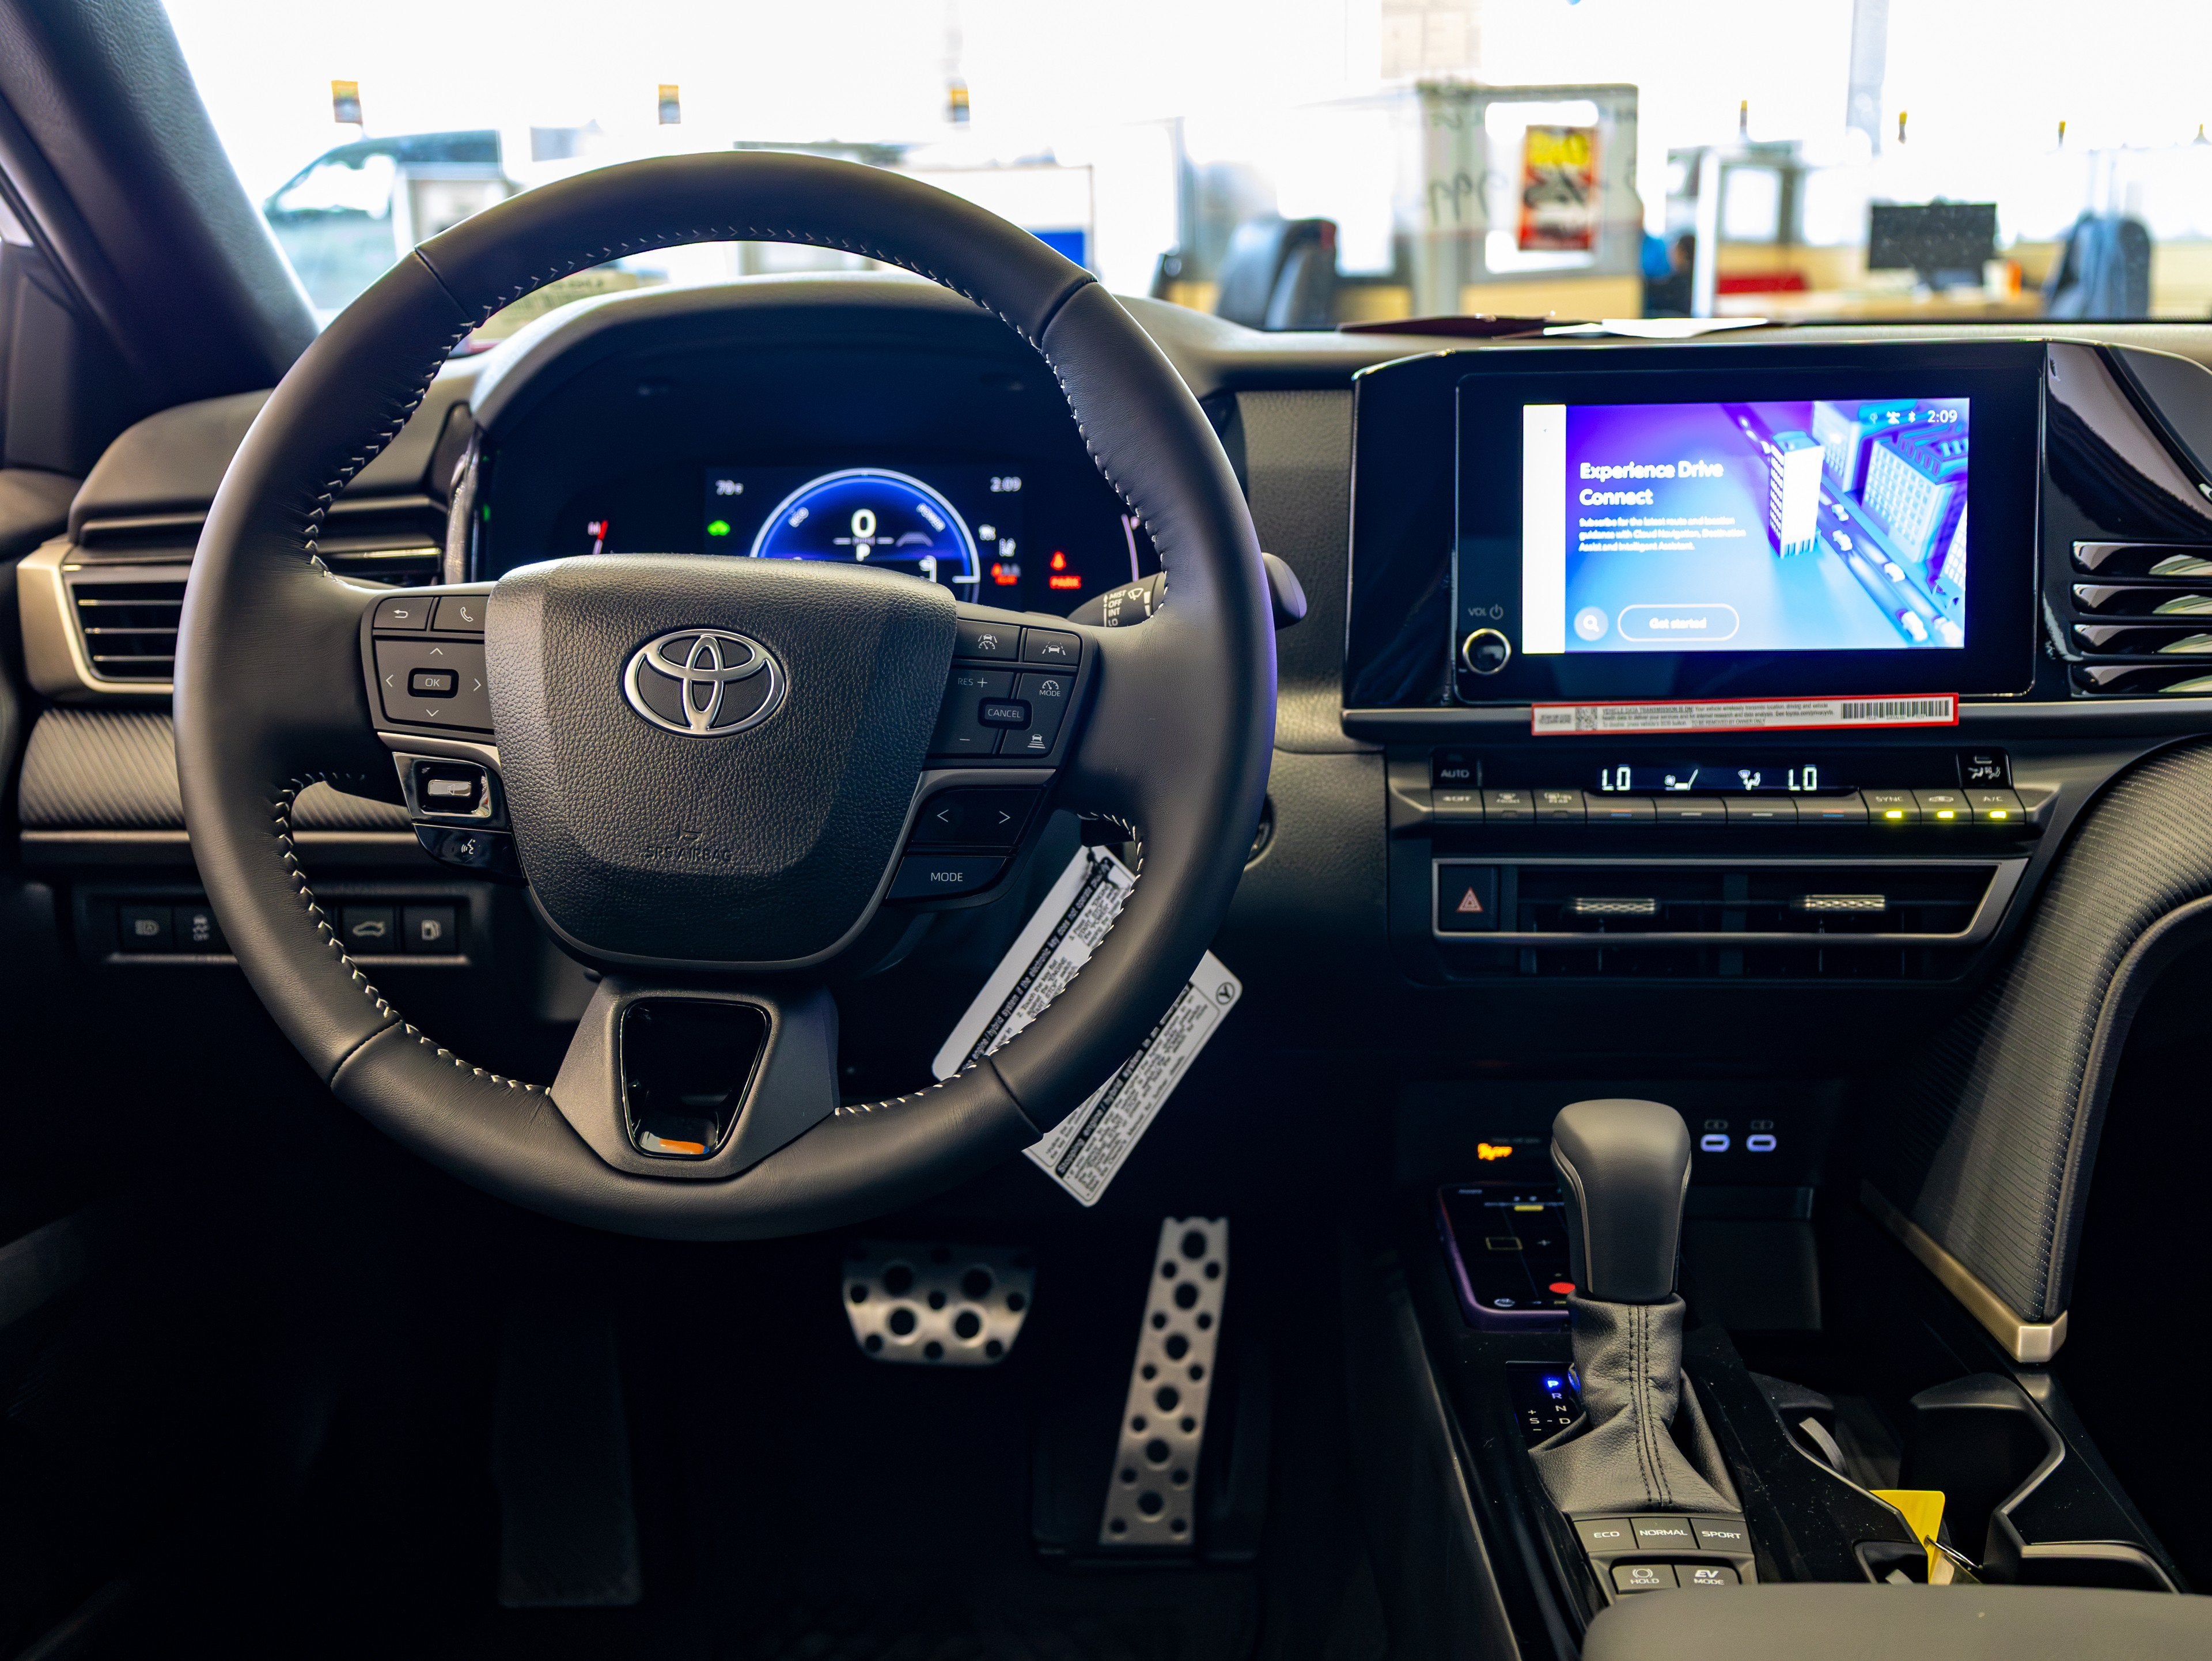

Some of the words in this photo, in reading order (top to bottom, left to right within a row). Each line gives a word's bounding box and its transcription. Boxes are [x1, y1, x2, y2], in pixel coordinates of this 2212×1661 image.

[1927, 410, 1957, 423] 2:09
[1580, 461, 1675, 482] Experience
[1678, 460, 1724, 478] Drive
[1580, 489, 1653, 505] Connect
[851, 508, 876, 538] 0
[856, 543, 870, 567] P
[1109, 590, 1127, 600] MIST
[1108, 599, 1123, 608] OFF
[1108, 608, 1121, 617] INT
[1468, 607, 1487, 616] VOL
[1649, 618, 1669, 629] Get
[1671, 617, 1707, 629] started
[425, 678, 440, 687] OK
[958, 678, 974, 686] RES
[987, 709, 1021, 718] CANCEL
[1441, 769, 1469, 778] AUTO
[931, 872, 963, 881] MODE
[1000, 992, 1021, 1017] system
[1020, 975, 1032, 989] the
[1027, 945, 1052, 978] electronic
[1046, 933, 1062, 950] key
[1055, 918, 1071, 937] does
[1066, 906, 1080, 921] not
[1074, 884, 1095, 910] operate
[1055, 1136, 1087, 1175] Stopping
[1120, 1048, 1146, 1079] system
[1702, 1531, 1741, 1539] SPORT
[1695, 1569, 1719, 1578] EV
